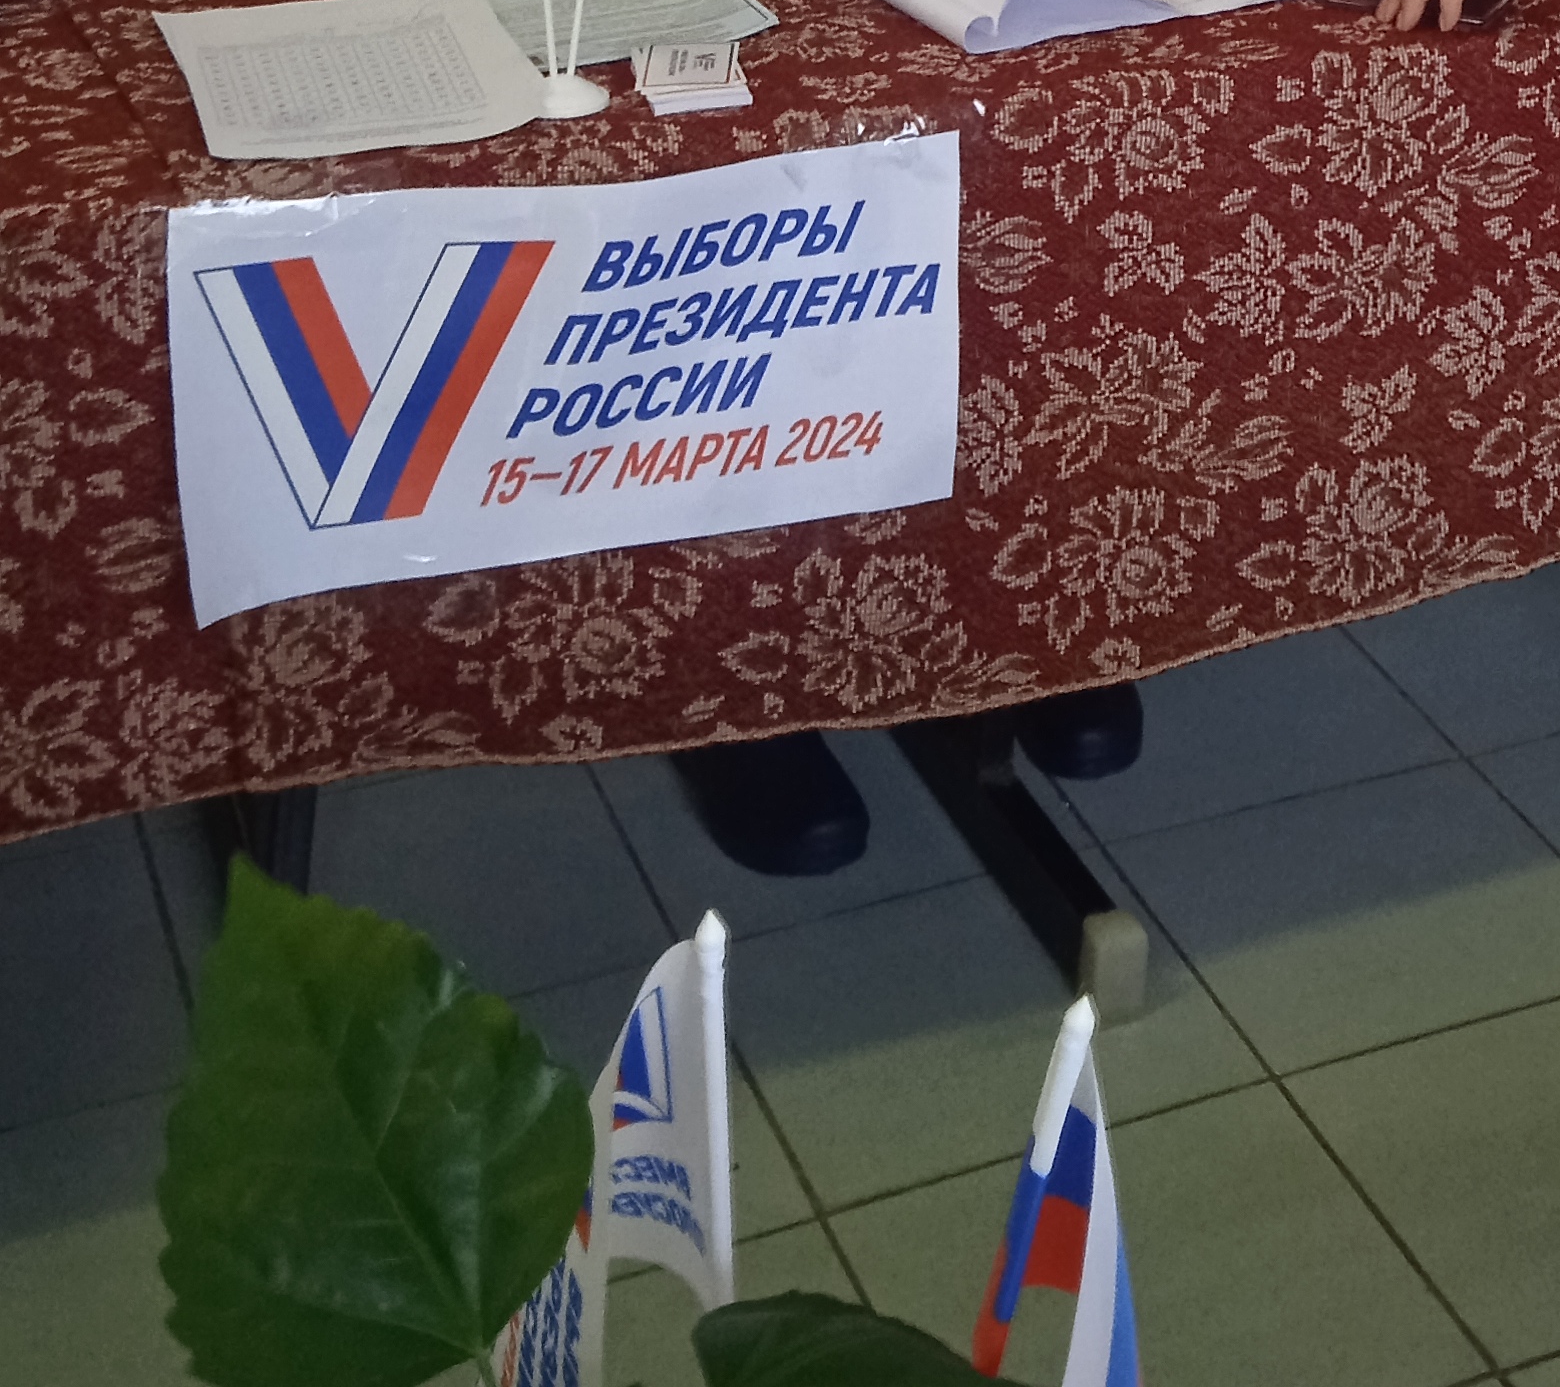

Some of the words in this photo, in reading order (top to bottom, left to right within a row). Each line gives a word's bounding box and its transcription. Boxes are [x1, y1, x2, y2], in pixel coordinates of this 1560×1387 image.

[582, 199, 866, 294] ВЫБОРЫ
[543, 262, 942, 367] ПРЕЗИДЕНТА
[507, 353, 773, 440] РОССИИ
[480, 447, 612, 507] 15–17
[612, 426, 765, 491] МАРТА
[774, 410, 884, 468] 2024
